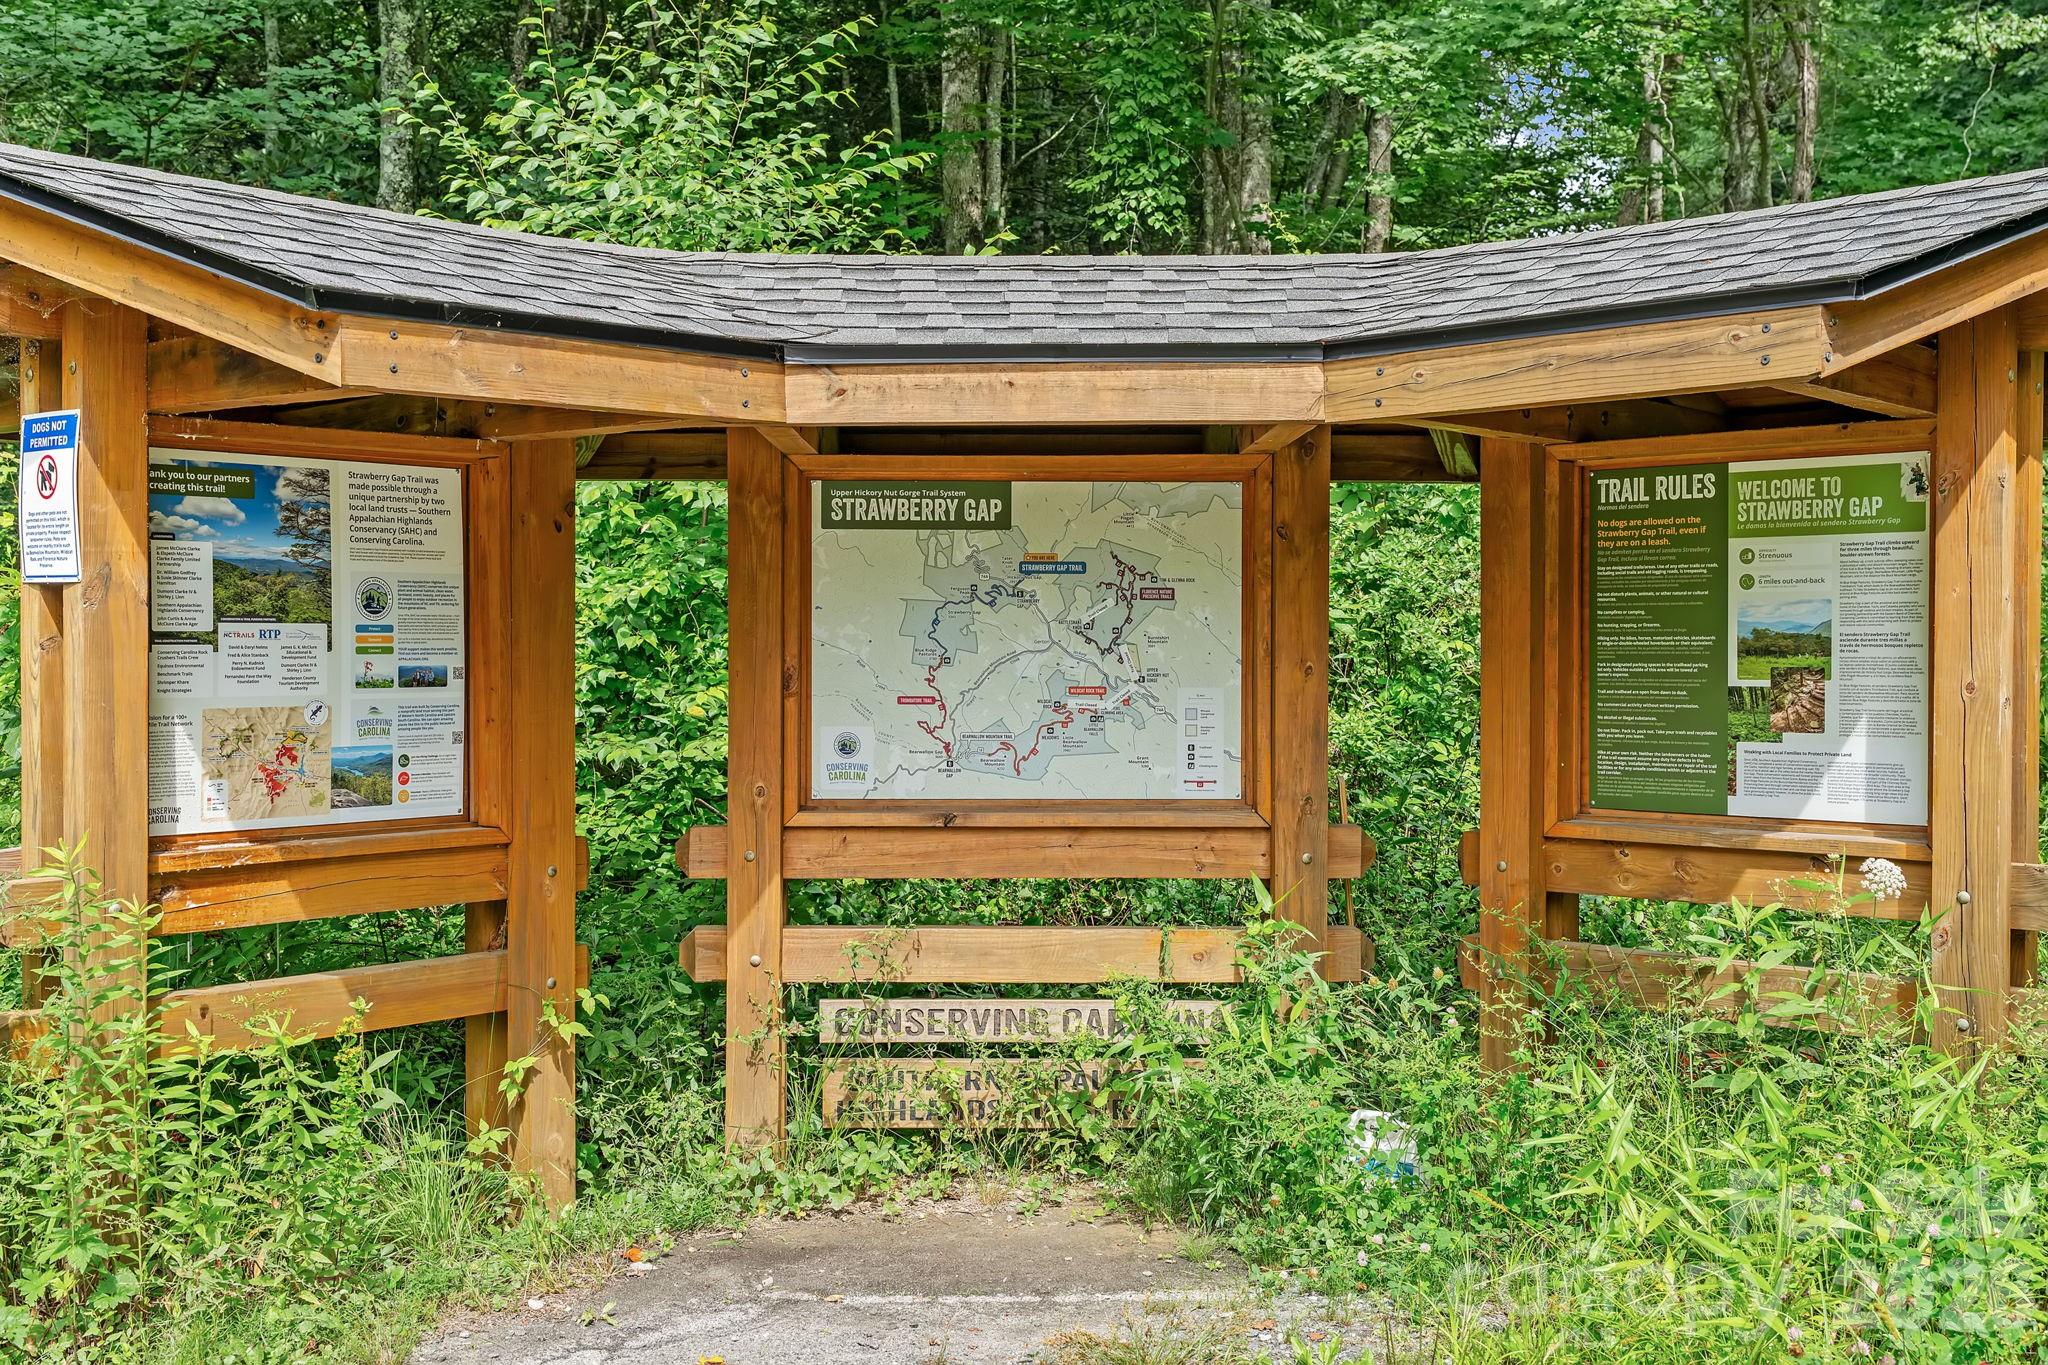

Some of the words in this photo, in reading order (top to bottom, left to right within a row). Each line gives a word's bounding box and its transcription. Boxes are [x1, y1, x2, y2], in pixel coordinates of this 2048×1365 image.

[32, 421, 50, 433] DOGS
[51, 420, 67, 430] NOT
[30, 435, 68, 448] PERMITTED
[149, 470, 166, 478] ank
[168, 472, 184, 480] you
[214, 474, 250, 483] partners
[348, 471, 390, 482] Strawberry
[391, 474, 405, 484] Gap
[407, 475, 423, 483] Trail
[149, 482, 186, 492] creating
[187, 483, 204, 492] this
[206, 484, 226, 493] trail!
[349, 482, 370, 491] made
[372, 484, 401, 493] possible
[402, 485, 431, 496] through
[830, 490, 853, 498] Upper
[855, 489, 882, 498] Hickory
[899, 490, 921, 498] Gorge
[940, 490, 966, 498] System
[1597, 477, 1650, 503] TRAIL
[1656, 473, 1716, 500] RULES
[1737, 478, 1816, 500] WELCOME
[1820, 476, 1841, 497] TO
[349, 493, 375, 502] unique
[377, 495, 419, 505] partnership
[421, 496, 430, 506] by
[349, 503, 367, 511] local
[368, 504, 384, 512] land
[386, 506, 408, 514] trusts
[418, 507, 451, 516] Southern
[831, 498, 958, 521] STRAWBERRY
[964, 499, 1002, 522] GAP
[1737, 498, 1844, 522] STRAWBERRY
[1850, 496, 1883, 517] GAP
[349, 514, 395, 524] Appalachian
[397, 516, 432, 526] Highlands
[1610, 520, 1627, 528] dogs
[1643, 517, 1674, 525] allowed
[1687, 516, 1701, 524] the
[1848, 518, 1886, 526] Strawberry
[1887, 517, 1901, 525] Gap
[350, 525, 397, 535] Conservancy
[398, 527, 422, 536] (SAHC)
[1597, 529, 1640, 538] Strawberry
[1641, 528, 1656, 537] Gap
[1657, 527, 1678, 535] Trail,
[1700, 525, 1707, 533] if
[350, 536, 391, 546] Conserving
[393, 537, 425, 546] Carolina.
[1597, 540, 1614, 549] they
[259, 629, 281, 638] RTP
[356, 719, 393, 728] CONSERVING
[358, 727, 390, 737] CAROLINA
[826, 762, 868, 772] CONSERVING
[828, 771, 866, 781] CAROLINA
[148, 807, 181, 815] ONSERVING
[834, 1008, 1049, 1036] CONSERVING
